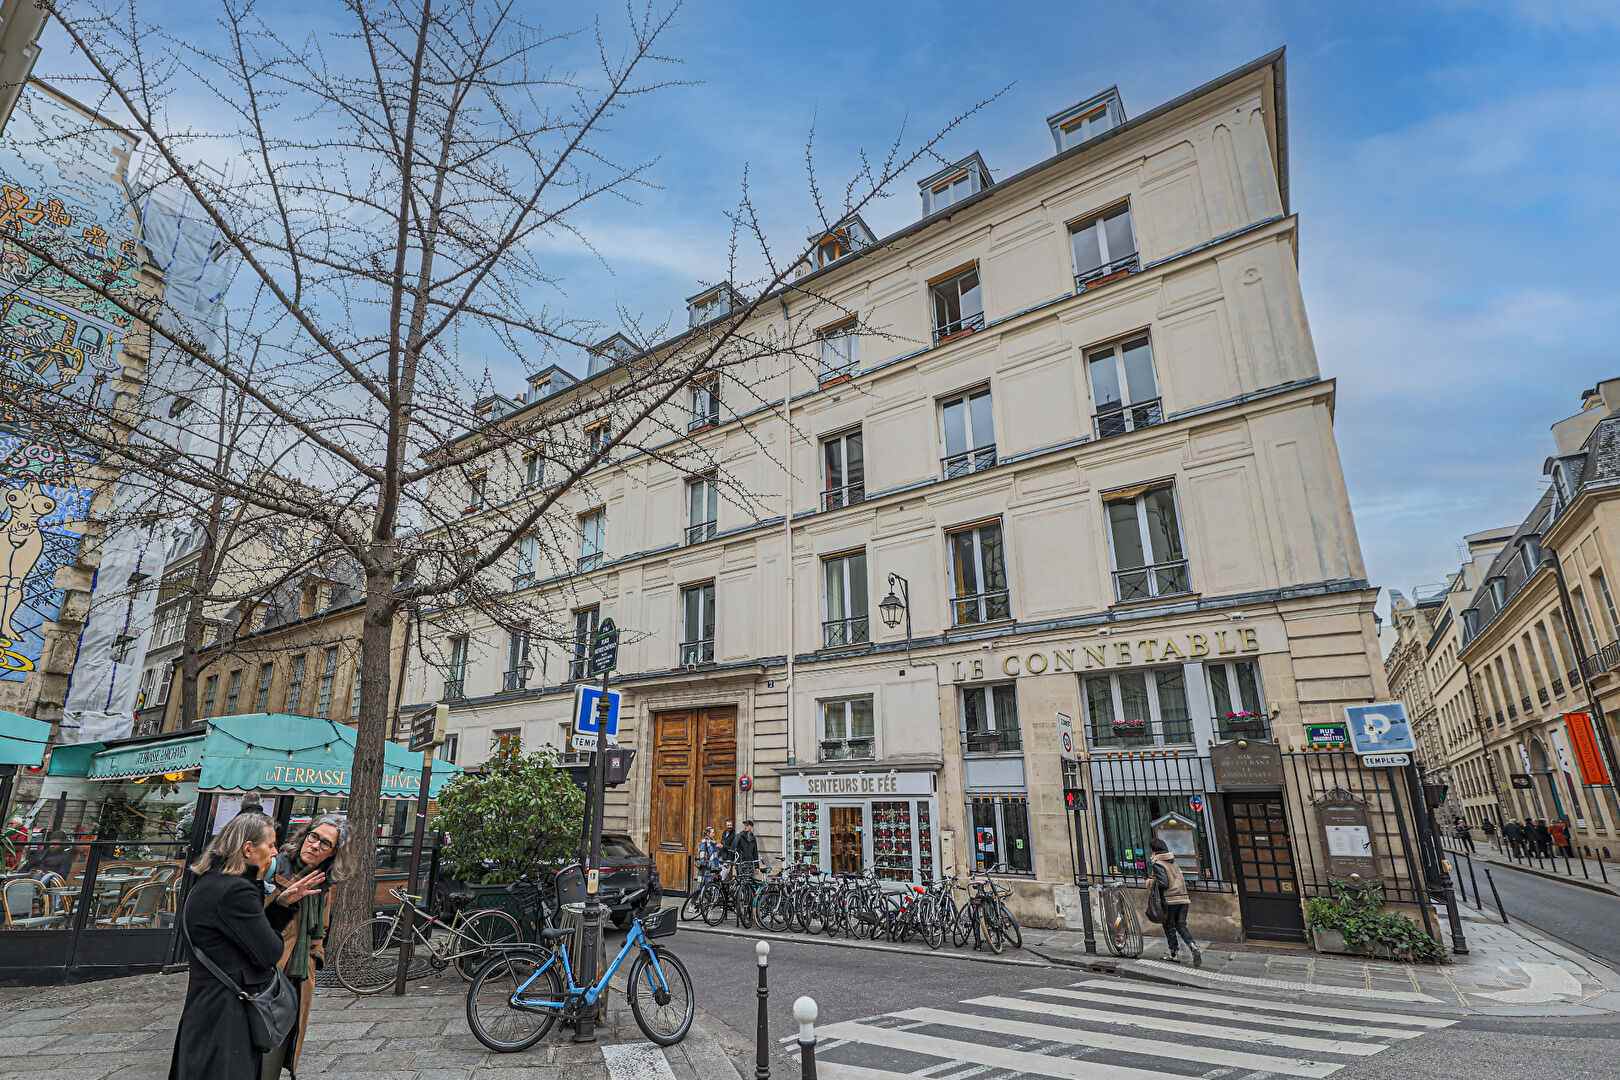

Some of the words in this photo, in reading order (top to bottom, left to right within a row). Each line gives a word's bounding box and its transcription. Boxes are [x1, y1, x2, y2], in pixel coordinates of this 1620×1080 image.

[952, 658, 985, 682] LE
[1002, 628, 1259, 676] CONNETABLE
[1364, 756, 1396, 765] TEMPLE
[274, 766, 349, 786] TERRASSE
[808, 777, 858, 794] SENTEURS
[861, 777, 874, 793] DE
[878, 774, 897, 792] FÉE
